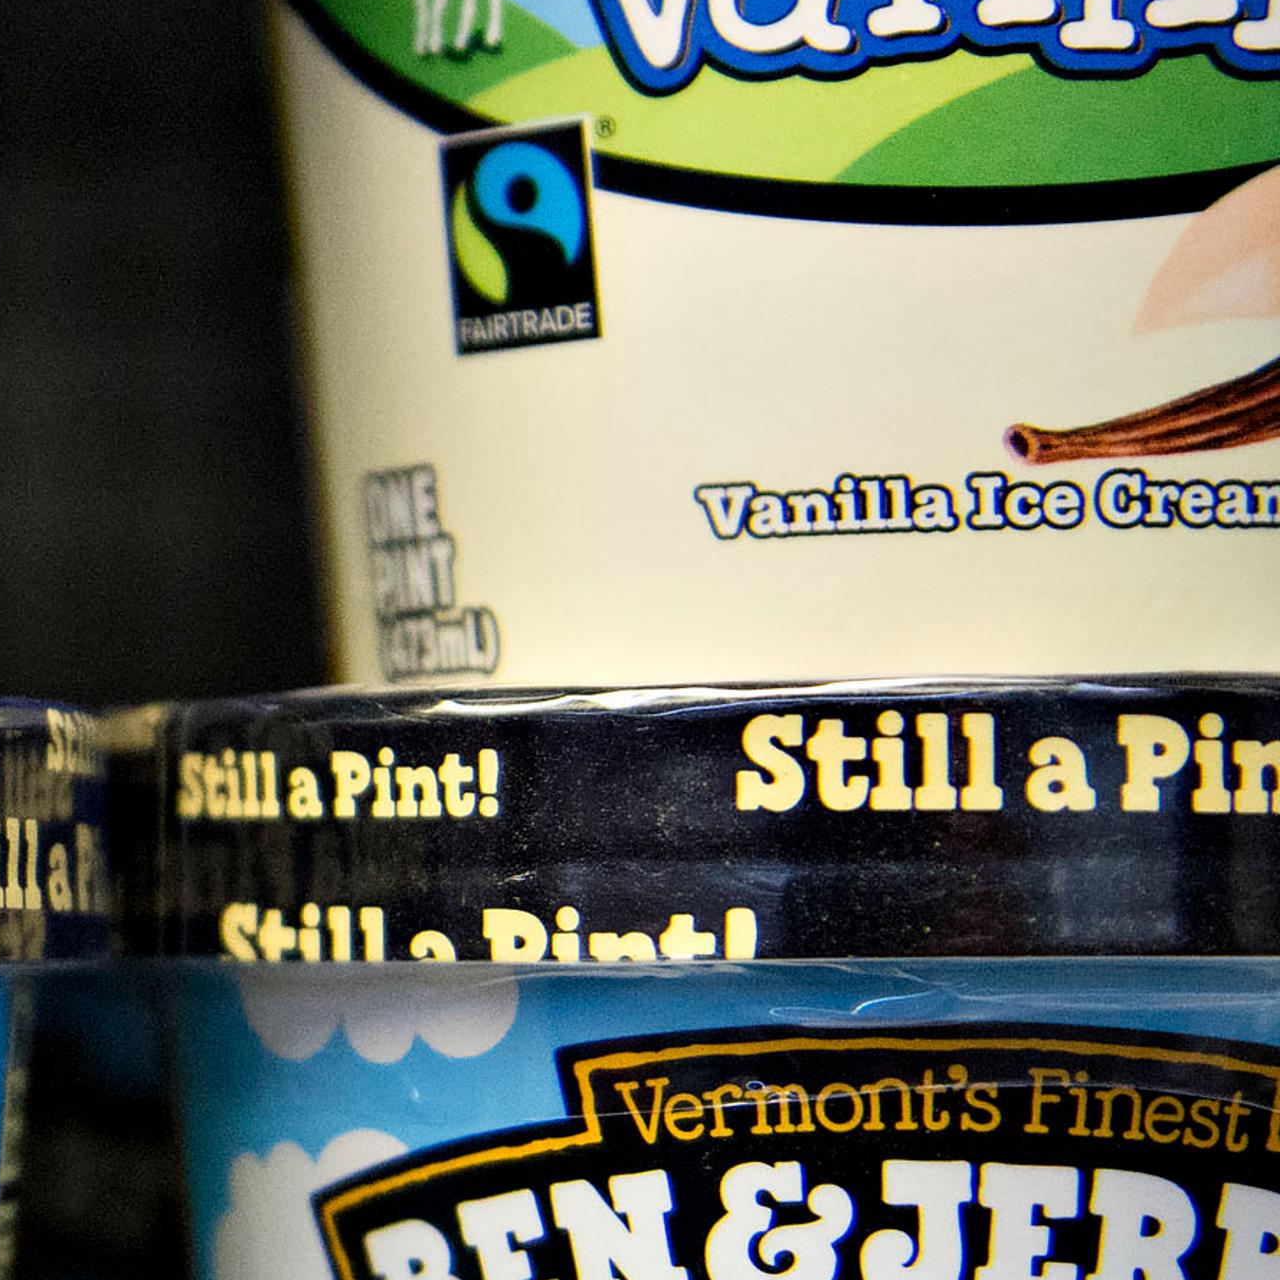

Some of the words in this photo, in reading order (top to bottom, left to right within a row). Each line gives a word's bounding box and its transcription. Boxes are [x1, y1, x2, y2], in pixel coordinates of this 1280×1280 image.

[459, 301, 592, 344] FAIRTRADE
[697, 474, 957, 539] Vanilla
[968, 473, 1085, 530] Ice
[176, 749, 280, 819] Still
[287, 766, 323, 819] a
[330, 746, 500, 819] Pint!
[735, 709, 1005, 813] Still
[1023, 736, 1097, 814] a
[47, 840, 74, 913] a
[615, 1064, 1001, 1144] Vermont's
[1023, 1069, 1252, 1152] Finest
